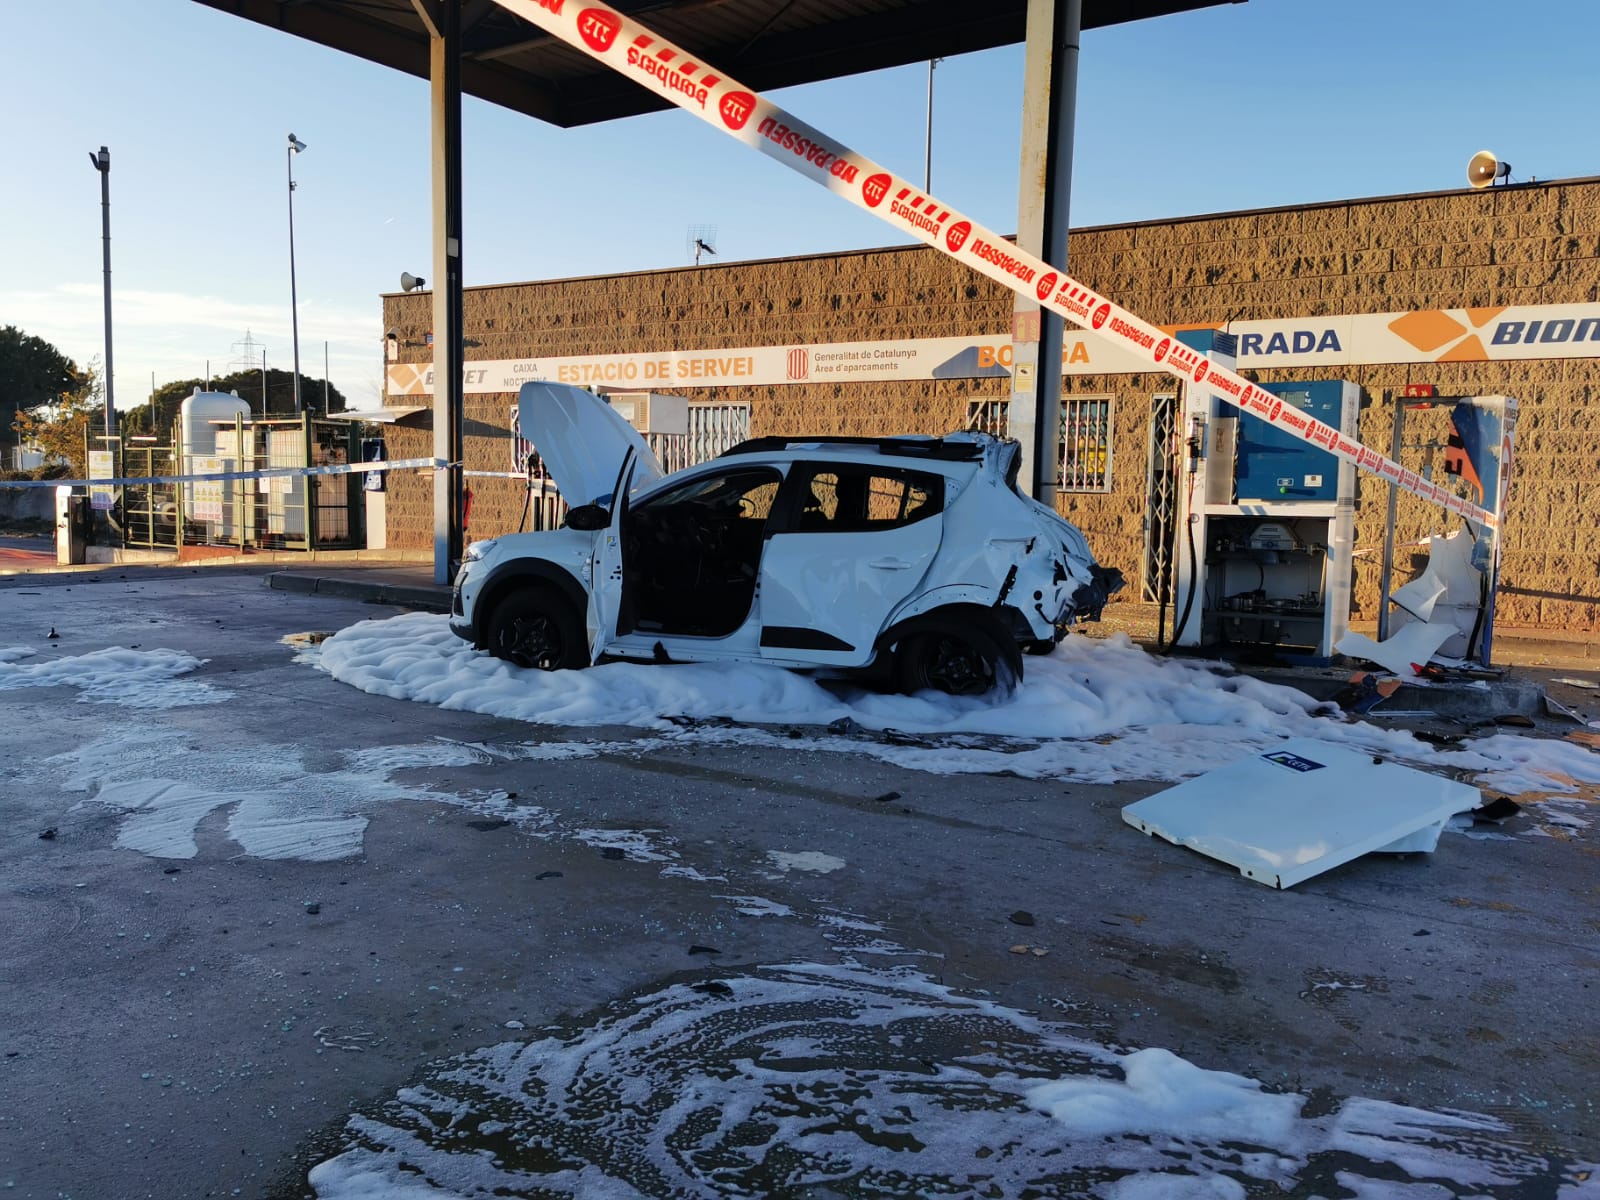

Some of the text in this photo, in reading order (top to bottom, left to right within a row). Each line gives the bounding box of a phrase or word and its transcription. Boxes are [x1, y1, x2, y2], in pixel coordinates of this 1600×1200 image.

[583, 16, 611, 43] 112
[627, 46, 709, 110] bombers
[723, 99, 746, 122] 112
[865, 181, 884, 200] 112
[890, 199, 941, 240] bombers
[814, 349, 917, 362] Generalitat de Catalunya
[1241, 329, 1342, 356] RADA
[513, 363, 538, 373] CAIXA
[558, 356, 753, 382] ESTACIÓ DE SERVEI
